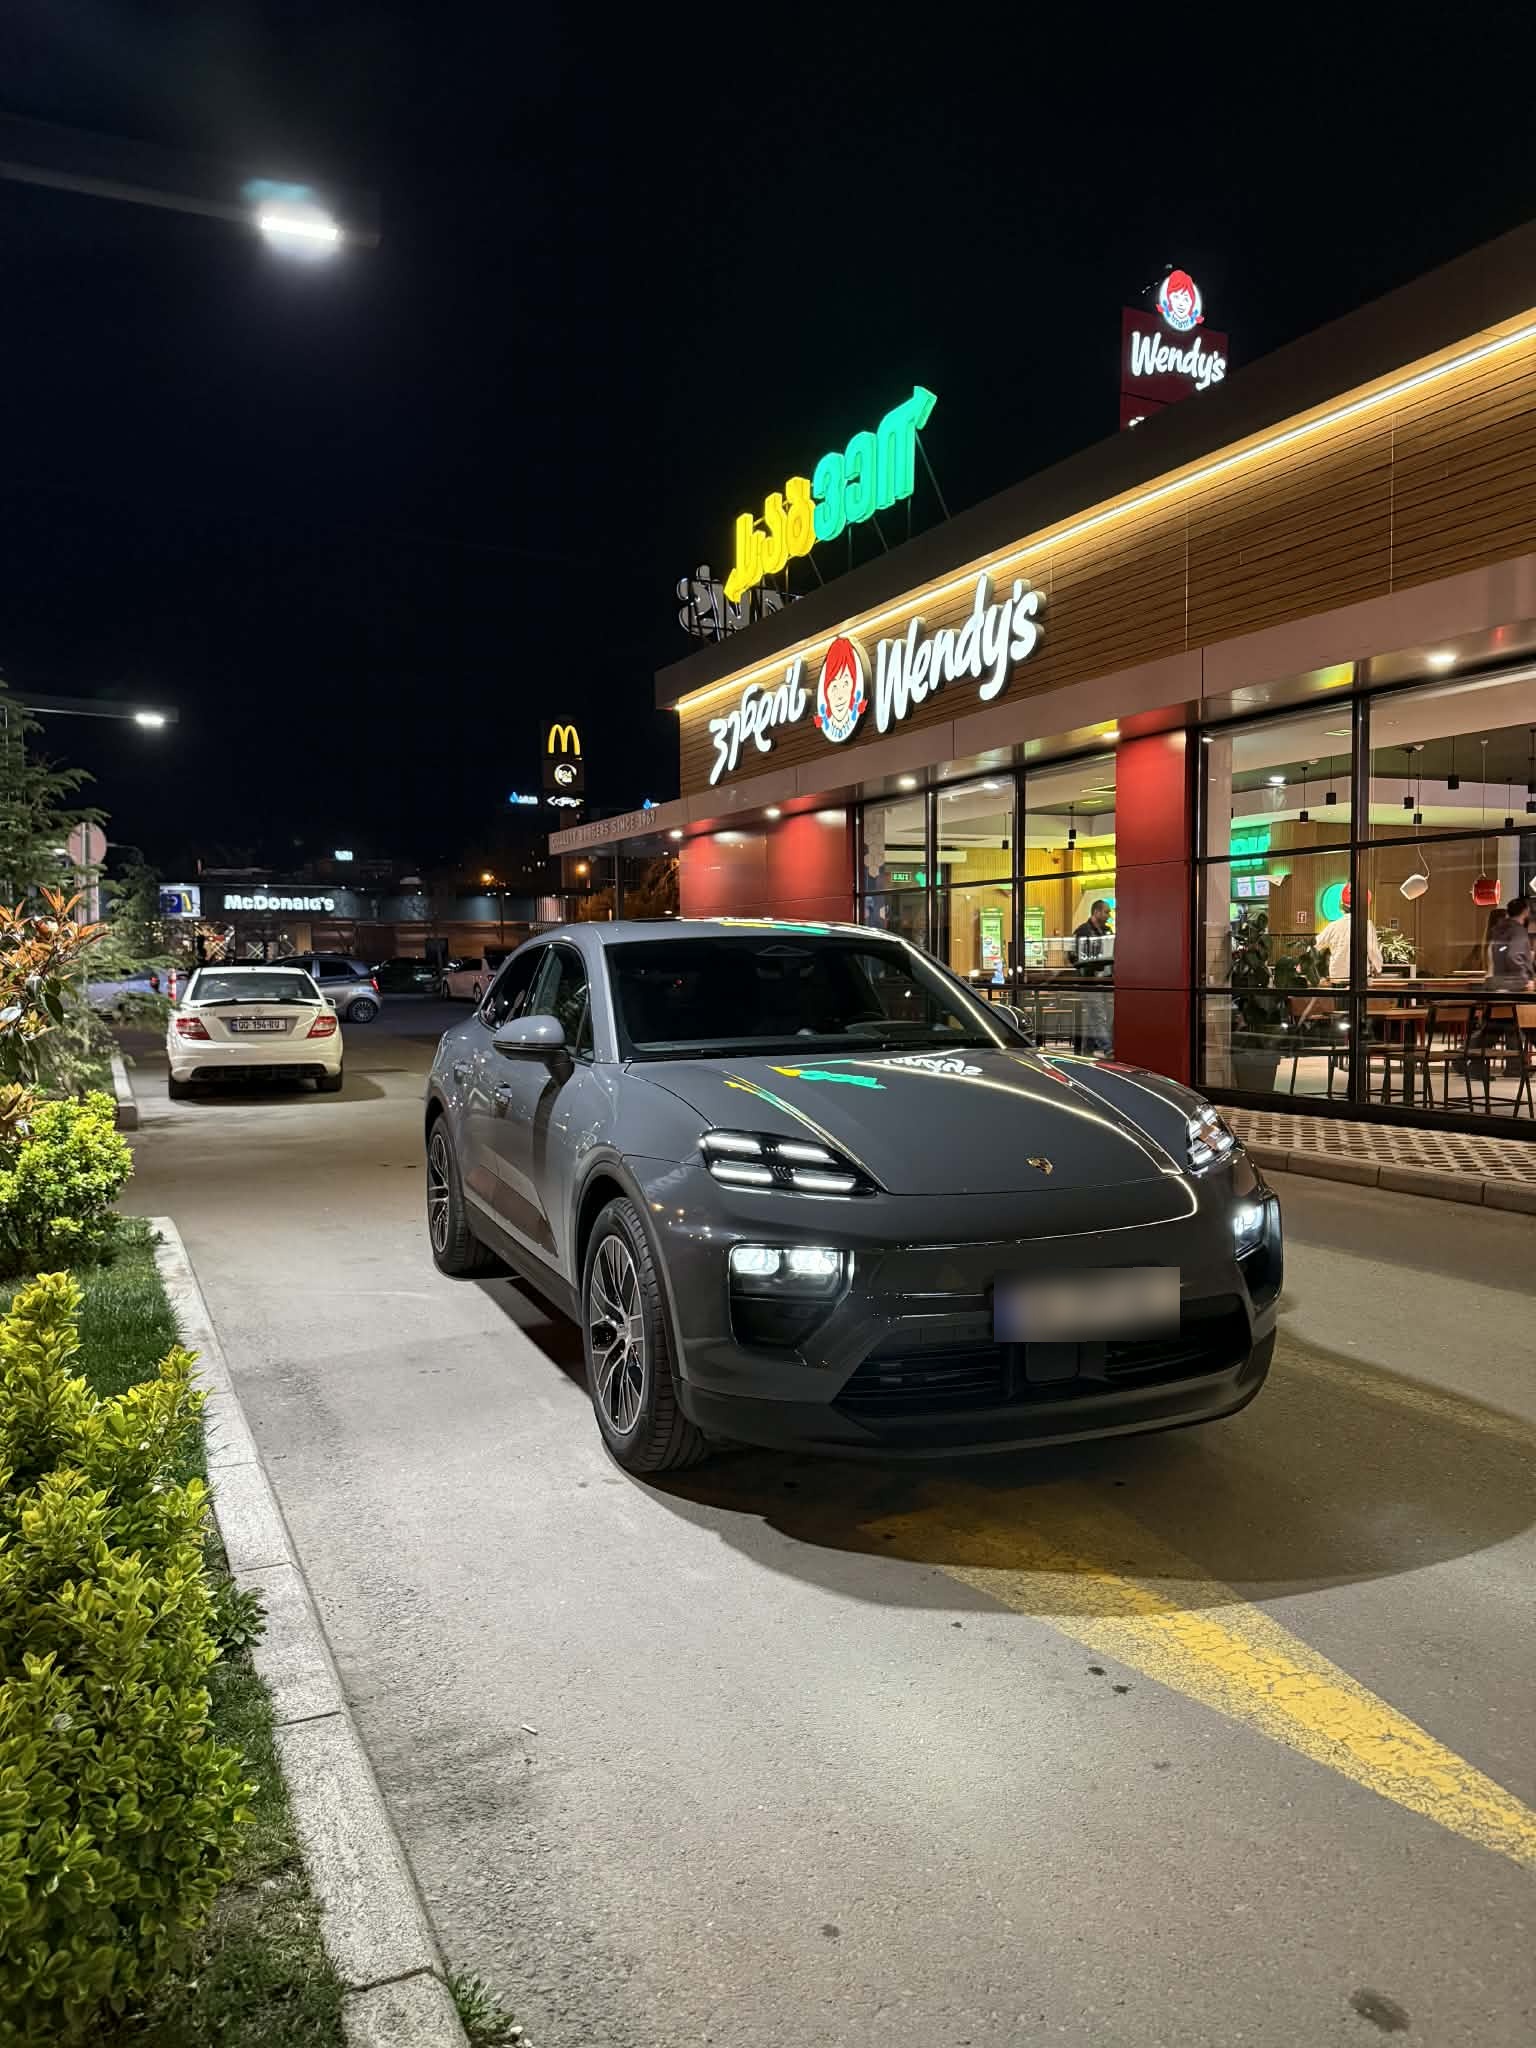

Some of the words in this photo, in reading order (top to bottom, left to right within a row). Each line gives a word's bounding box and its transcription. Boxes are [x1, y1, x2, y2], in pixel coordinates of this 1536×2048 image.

[1131, 331, 1226, 391] Wendy's
[875, 572, 1045, 733] Wendy's
[611, 816, 636, 833] SINCE
[639, 810, 657, 828] 1969
[224, 894, 335, 912] McDonald's
